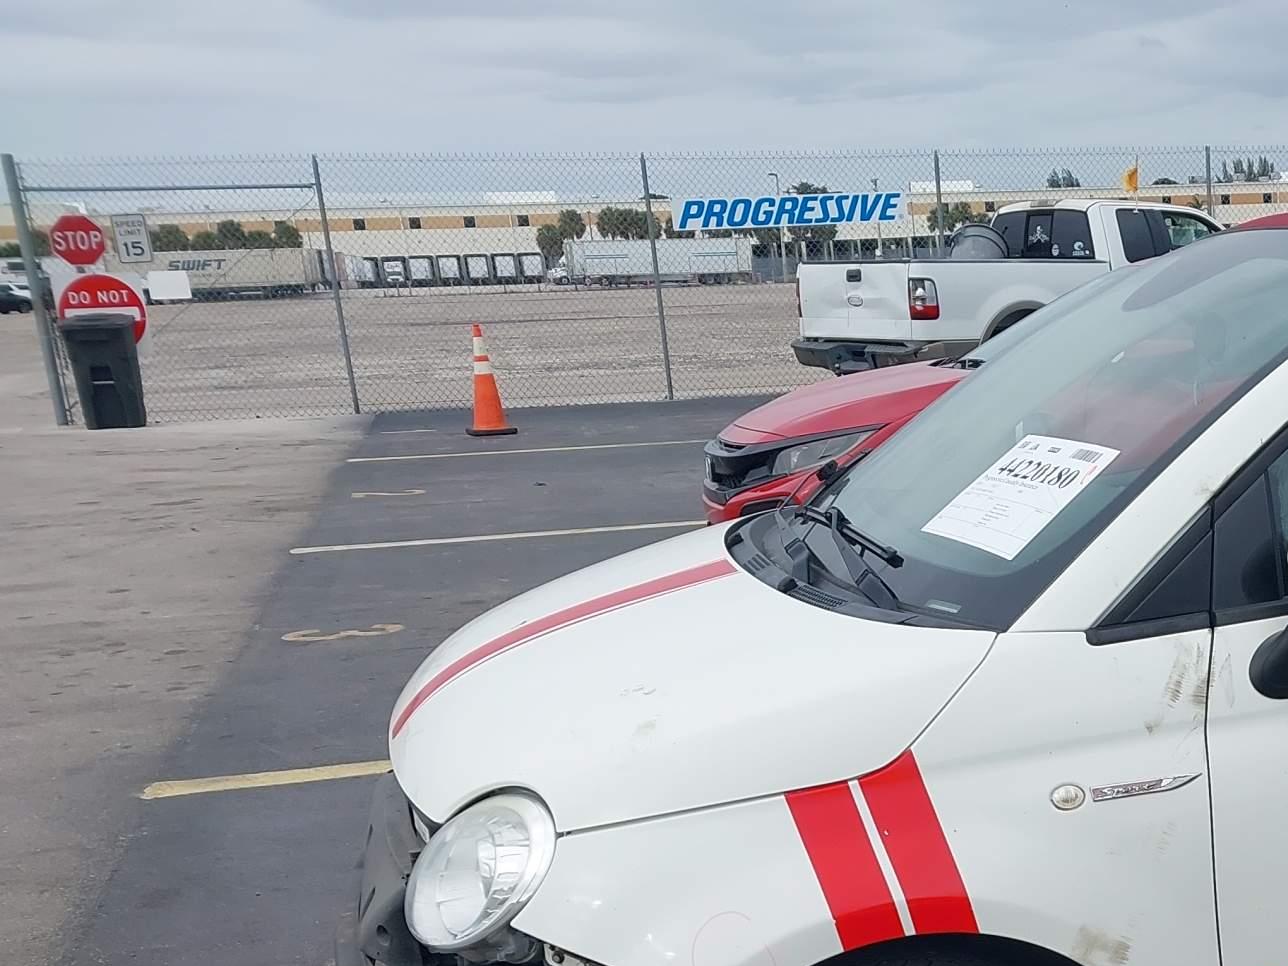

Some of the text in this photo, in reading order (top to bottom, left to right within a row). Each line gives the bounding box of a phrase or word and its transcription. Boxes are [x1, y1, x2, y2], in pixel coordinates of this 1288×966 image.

[678, 193, 901, 229] PROGRESSIVE
[53, 230, 101, 251] STOP
[123, 241, 145, 257] 15
[168, 258, 226, 271] SWIFT
[68, 290, 129, 304] DO NOT
[998, 457, 1080, 489] 44220180
